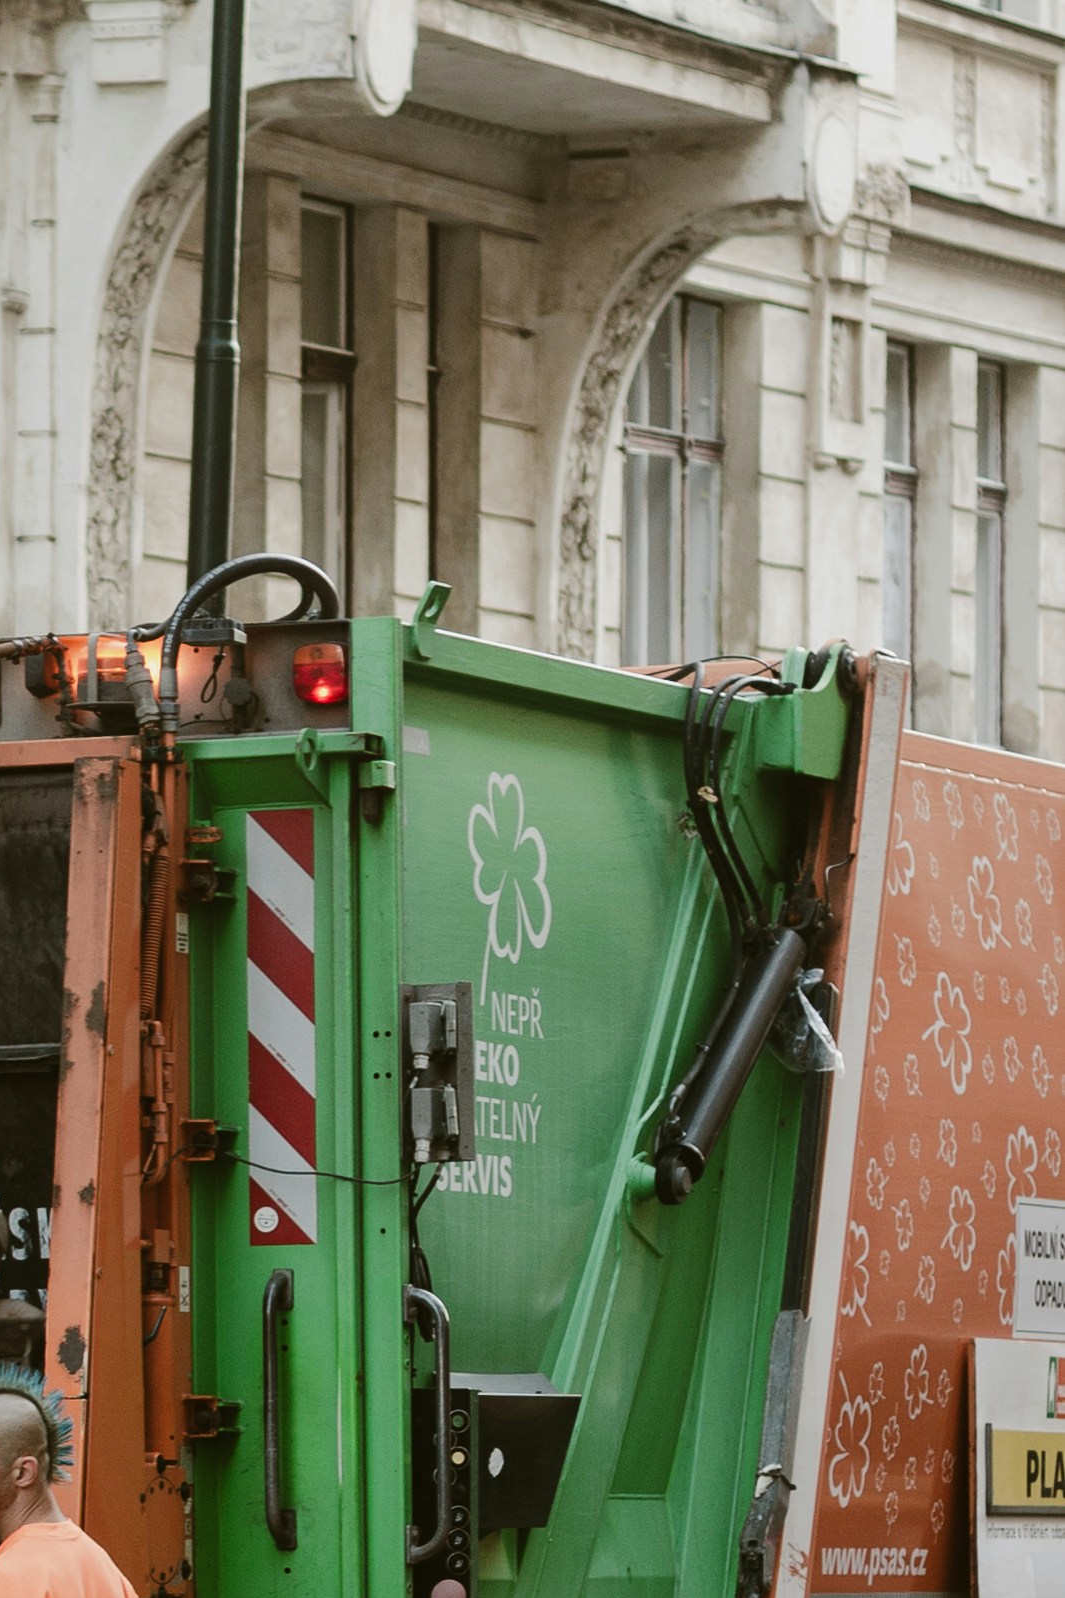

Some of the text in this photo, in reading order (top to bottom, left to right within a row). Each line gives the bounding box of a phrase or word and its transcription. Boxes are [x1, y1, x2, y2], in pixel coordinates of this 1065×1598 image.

[491, 988, 544, 1038] NEPŘ
[475, 1040, 520, 1087] EKO
[475, 1093, 542, 1144] TELNÝ
[436, 1153, 513, 1198] SERVIS
[1024, 1225, 1058, 1259] MOBILNÍ
[1035, 1279, 1065, 1309] ODPAD
[821, 1547, 929, 1586] www.psas.cz
